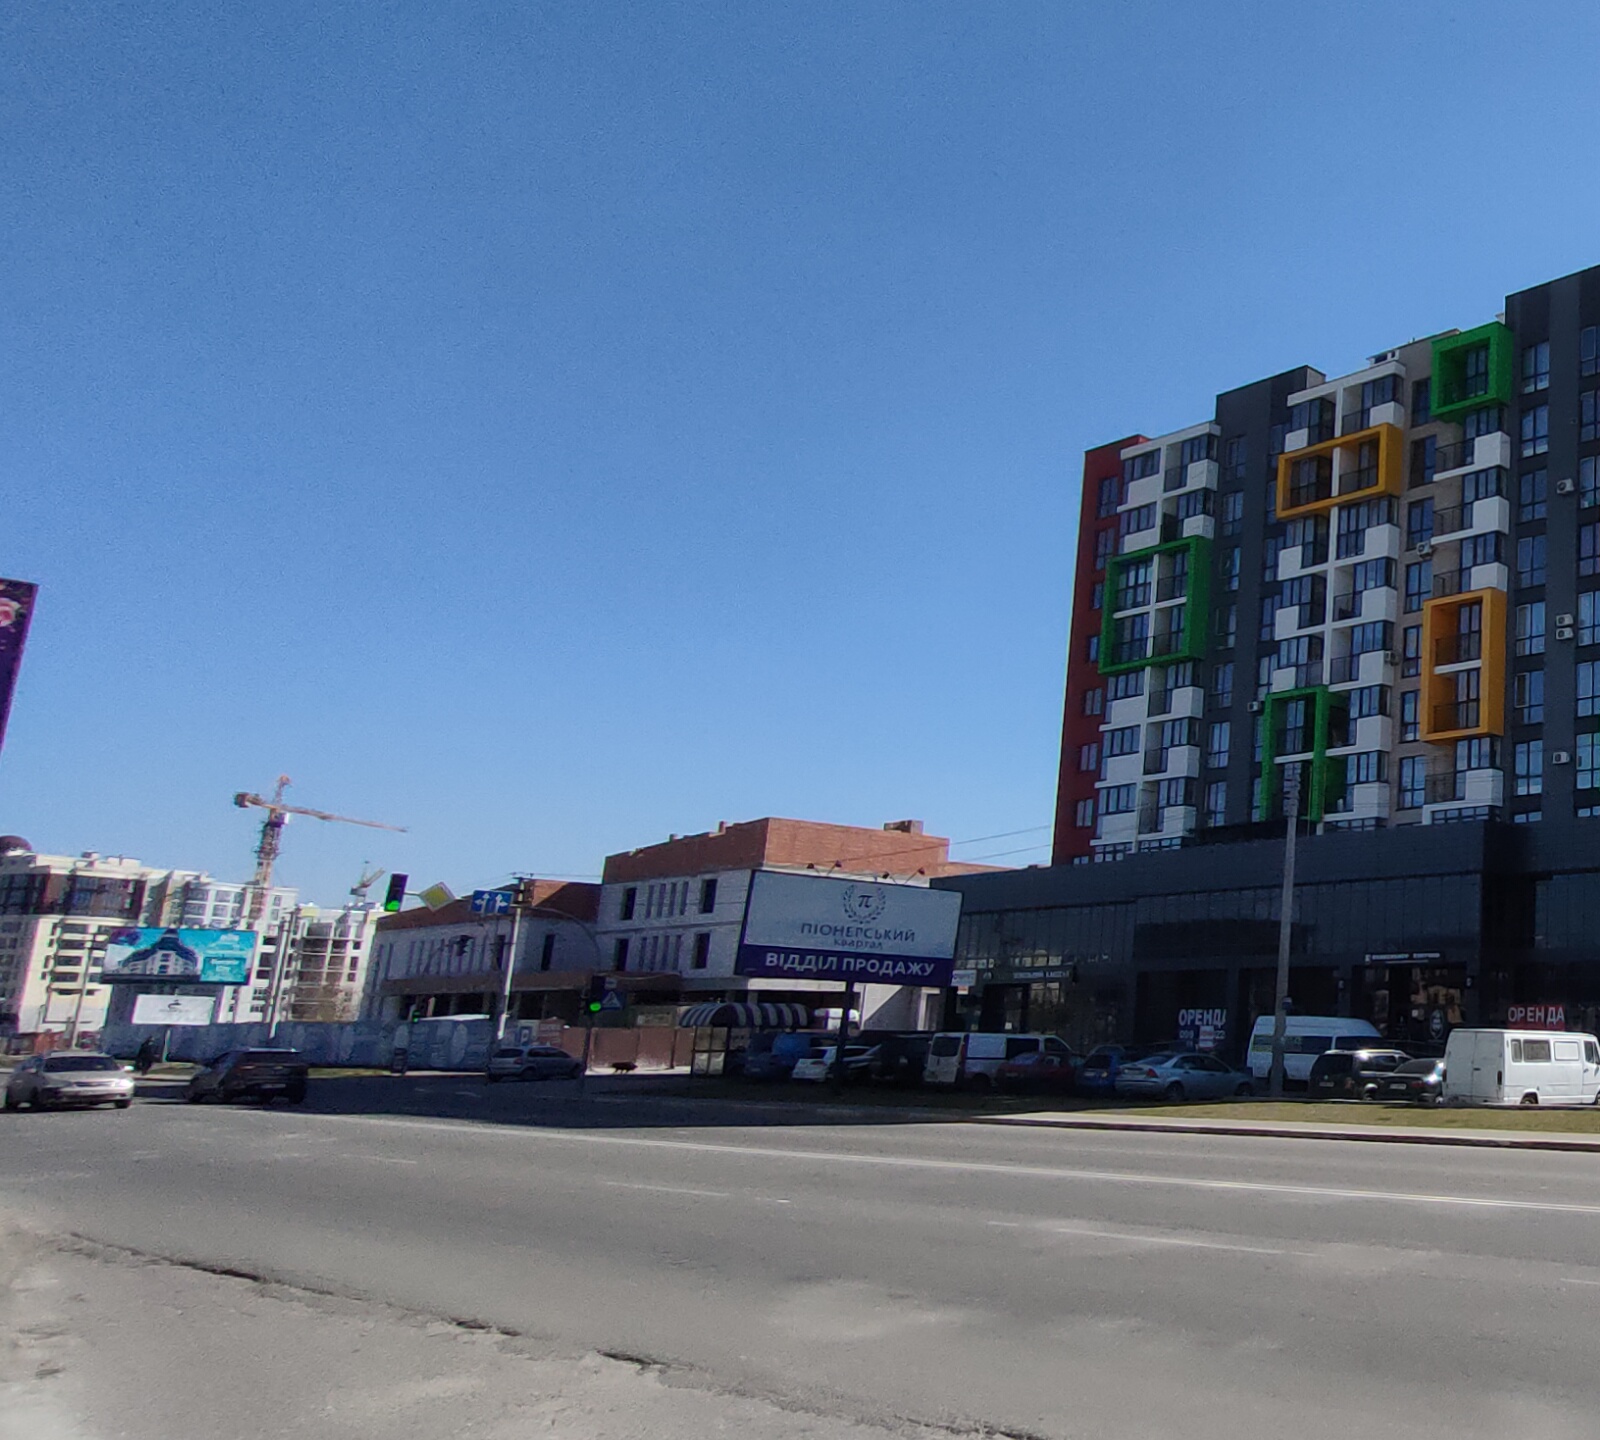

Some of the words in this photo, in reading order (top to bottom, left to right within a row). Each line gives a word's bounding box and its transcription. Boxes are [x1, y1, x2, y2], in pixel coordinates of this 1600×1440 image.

[800, 922, 916, 943] ПІОНЕРСЬКИЙ
[833, 938, 883, 950] квартал
[765, 952, 837, 972] ВІДДІЛ
[842, 957, 935, 978] ПРОДАЖУ
[1507, 1006, 1565, 1026] ОРЕНДА
